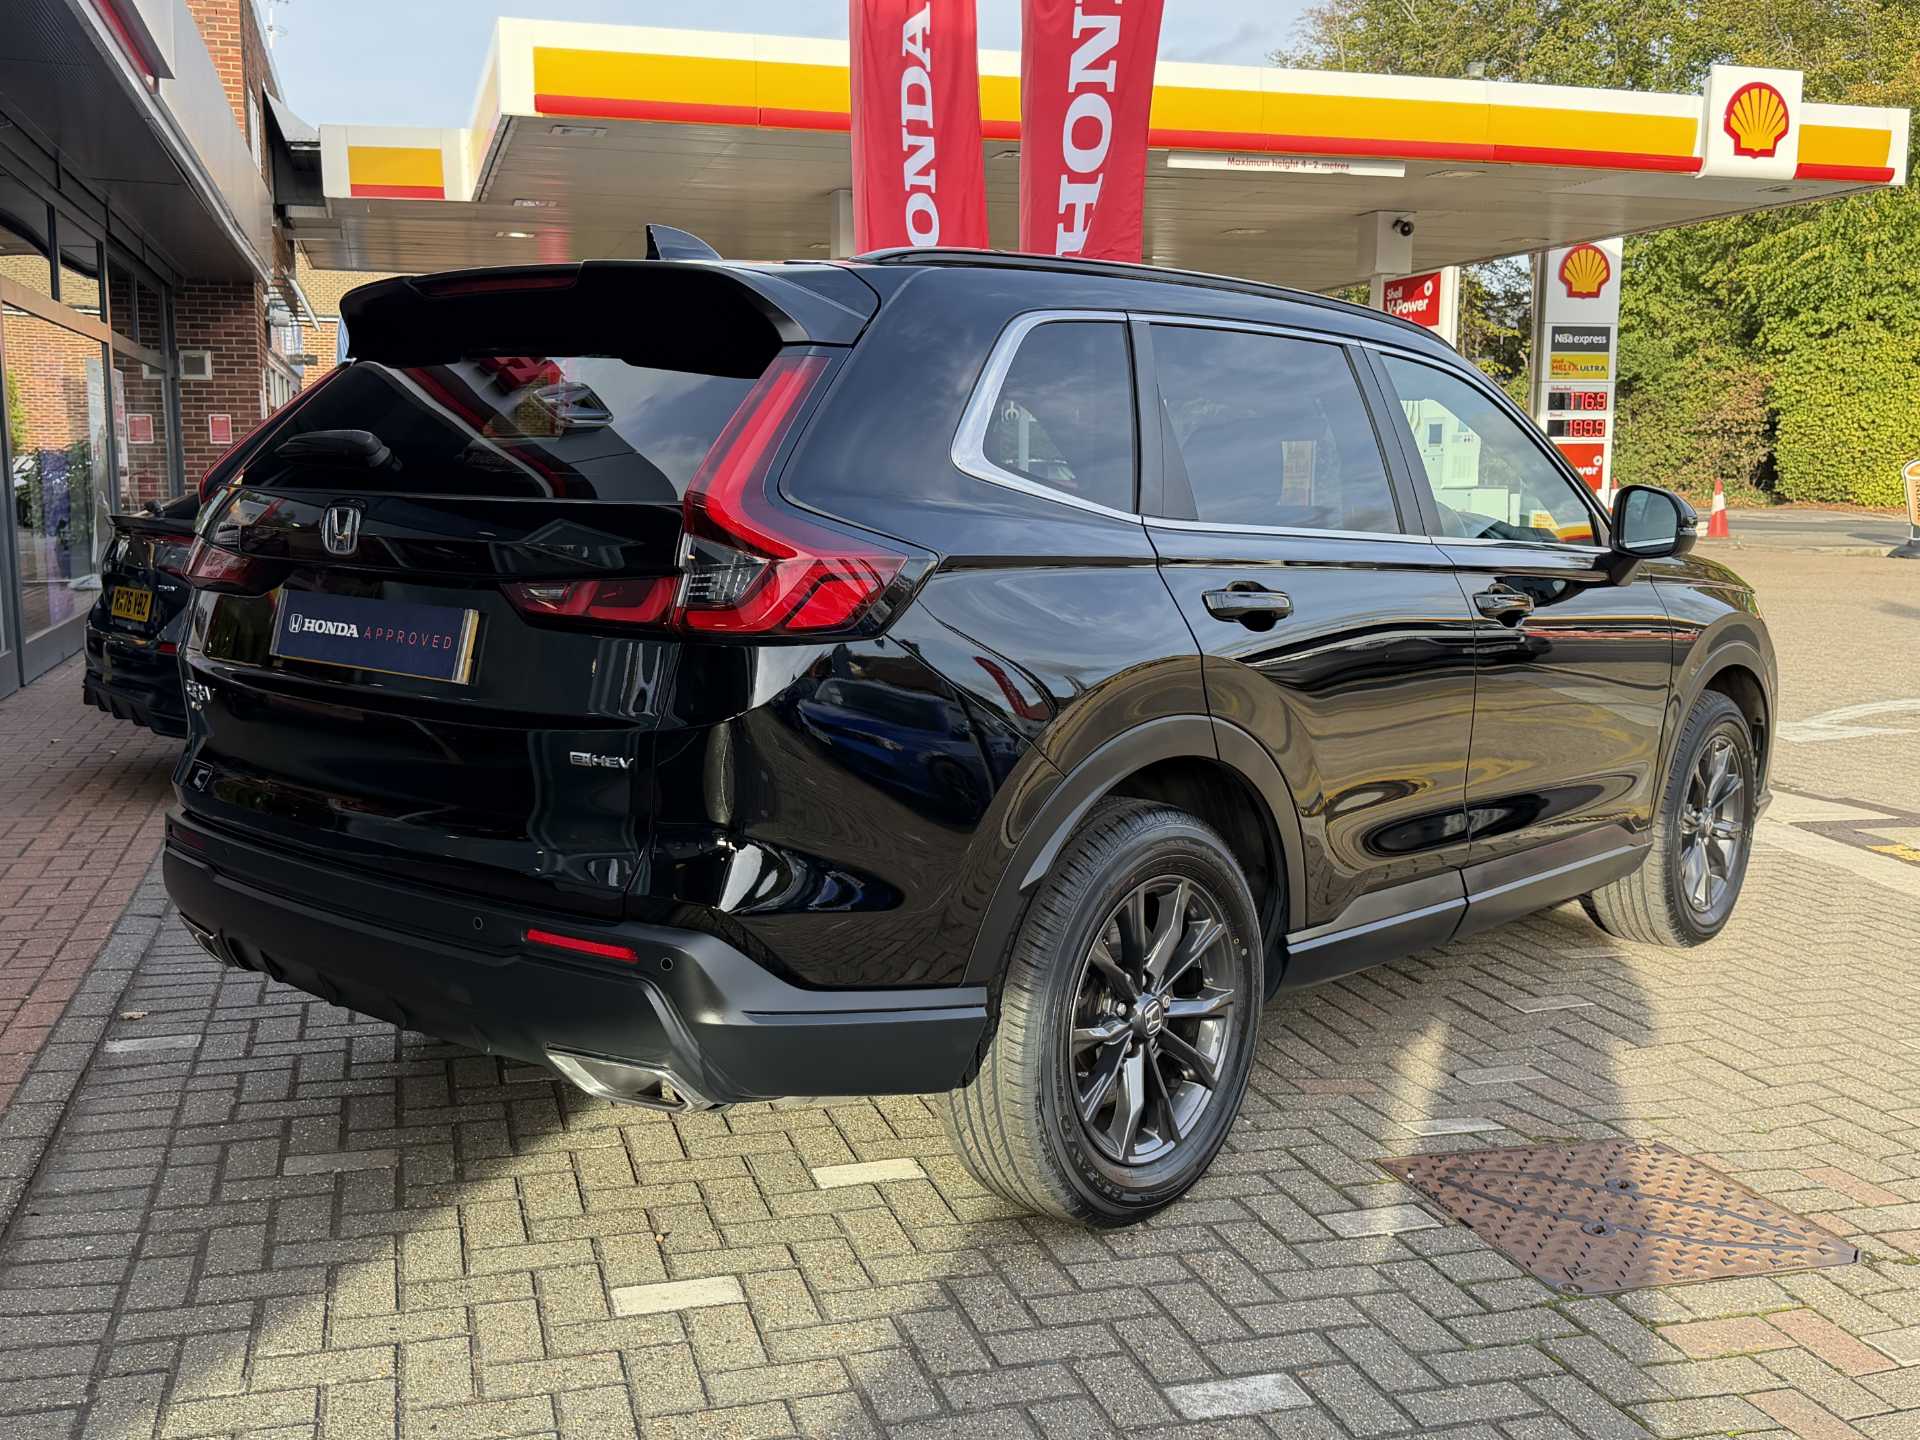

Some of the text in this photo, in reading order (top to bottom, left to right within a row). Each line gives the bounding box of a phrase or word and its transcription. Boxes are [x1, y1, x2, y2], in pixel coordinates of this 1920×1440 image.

[1056, 0, 1122, 256] HON
[1227, 157, 1269, 167] Maximum
[1272, 158, 1299, 170] height
[1321, 161, 1350, 170] metres
[1387, 286, 1403, 300] Shell
[1574, 335, 1607, 345] express
[302, 618, 452, 649] HONDA APPROVED
